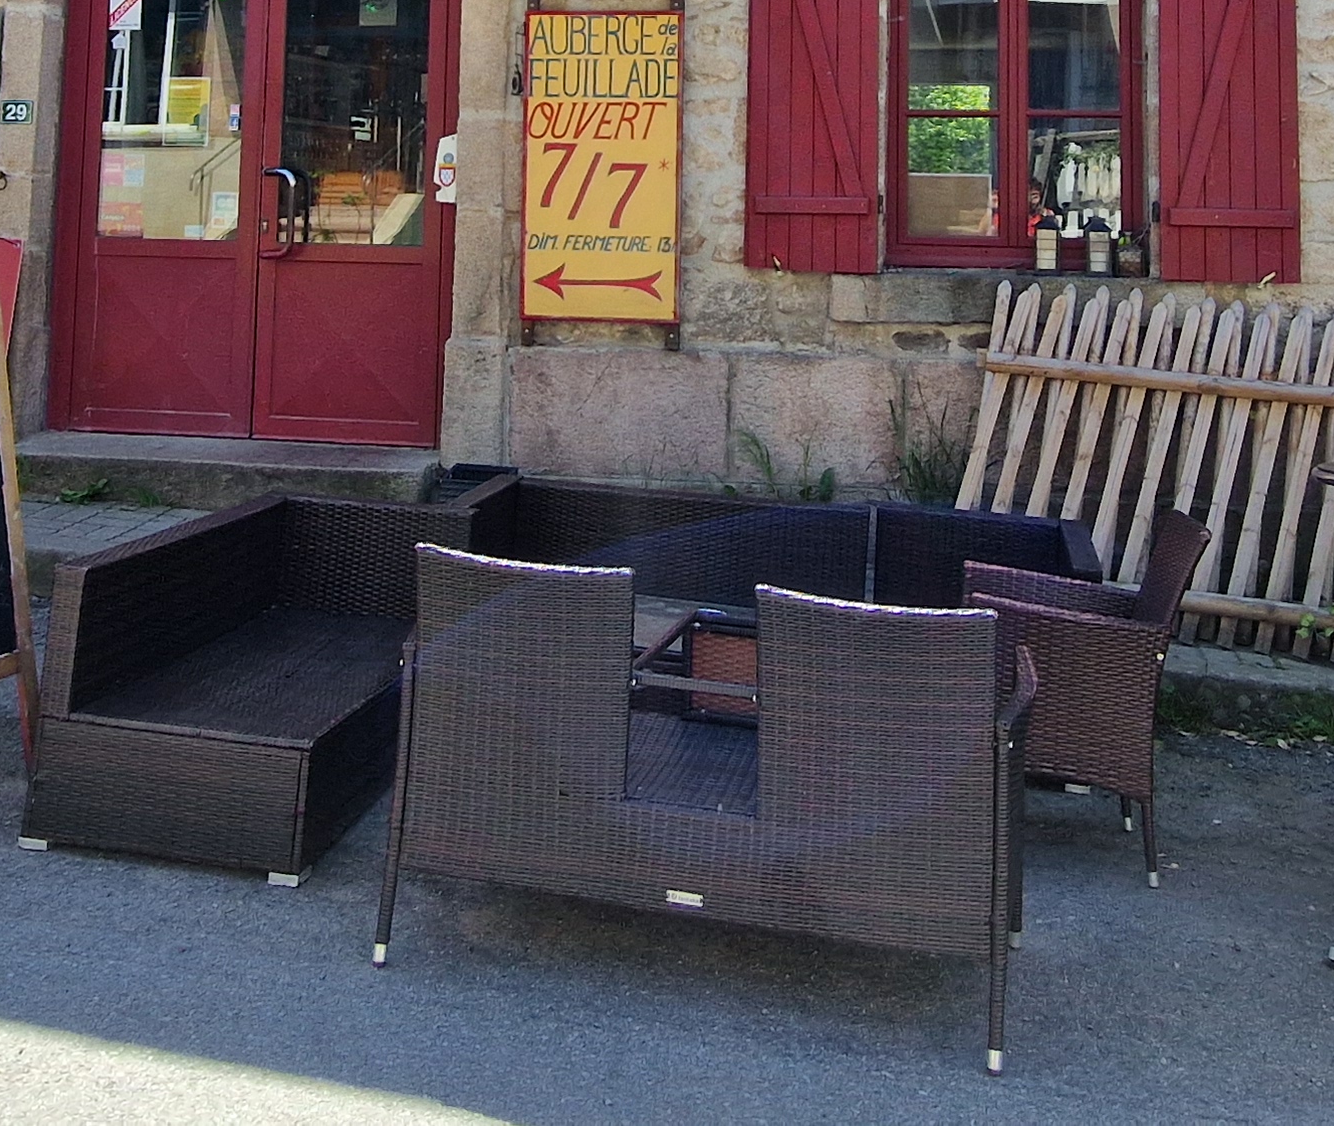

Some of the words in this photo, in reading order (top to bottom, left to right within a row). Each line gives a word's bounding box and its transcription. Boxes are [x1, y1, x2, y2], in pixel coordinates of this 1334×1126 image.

[529, 15, 657, 56] AUBERGE
[658, 16, 678, 36] de
[660, 36, 677, 56] la
[529, 58, 679, 99] FEUILLADE
[5, 104, 27, 121] 29
[528, 101, 667, 141] OUVERT
